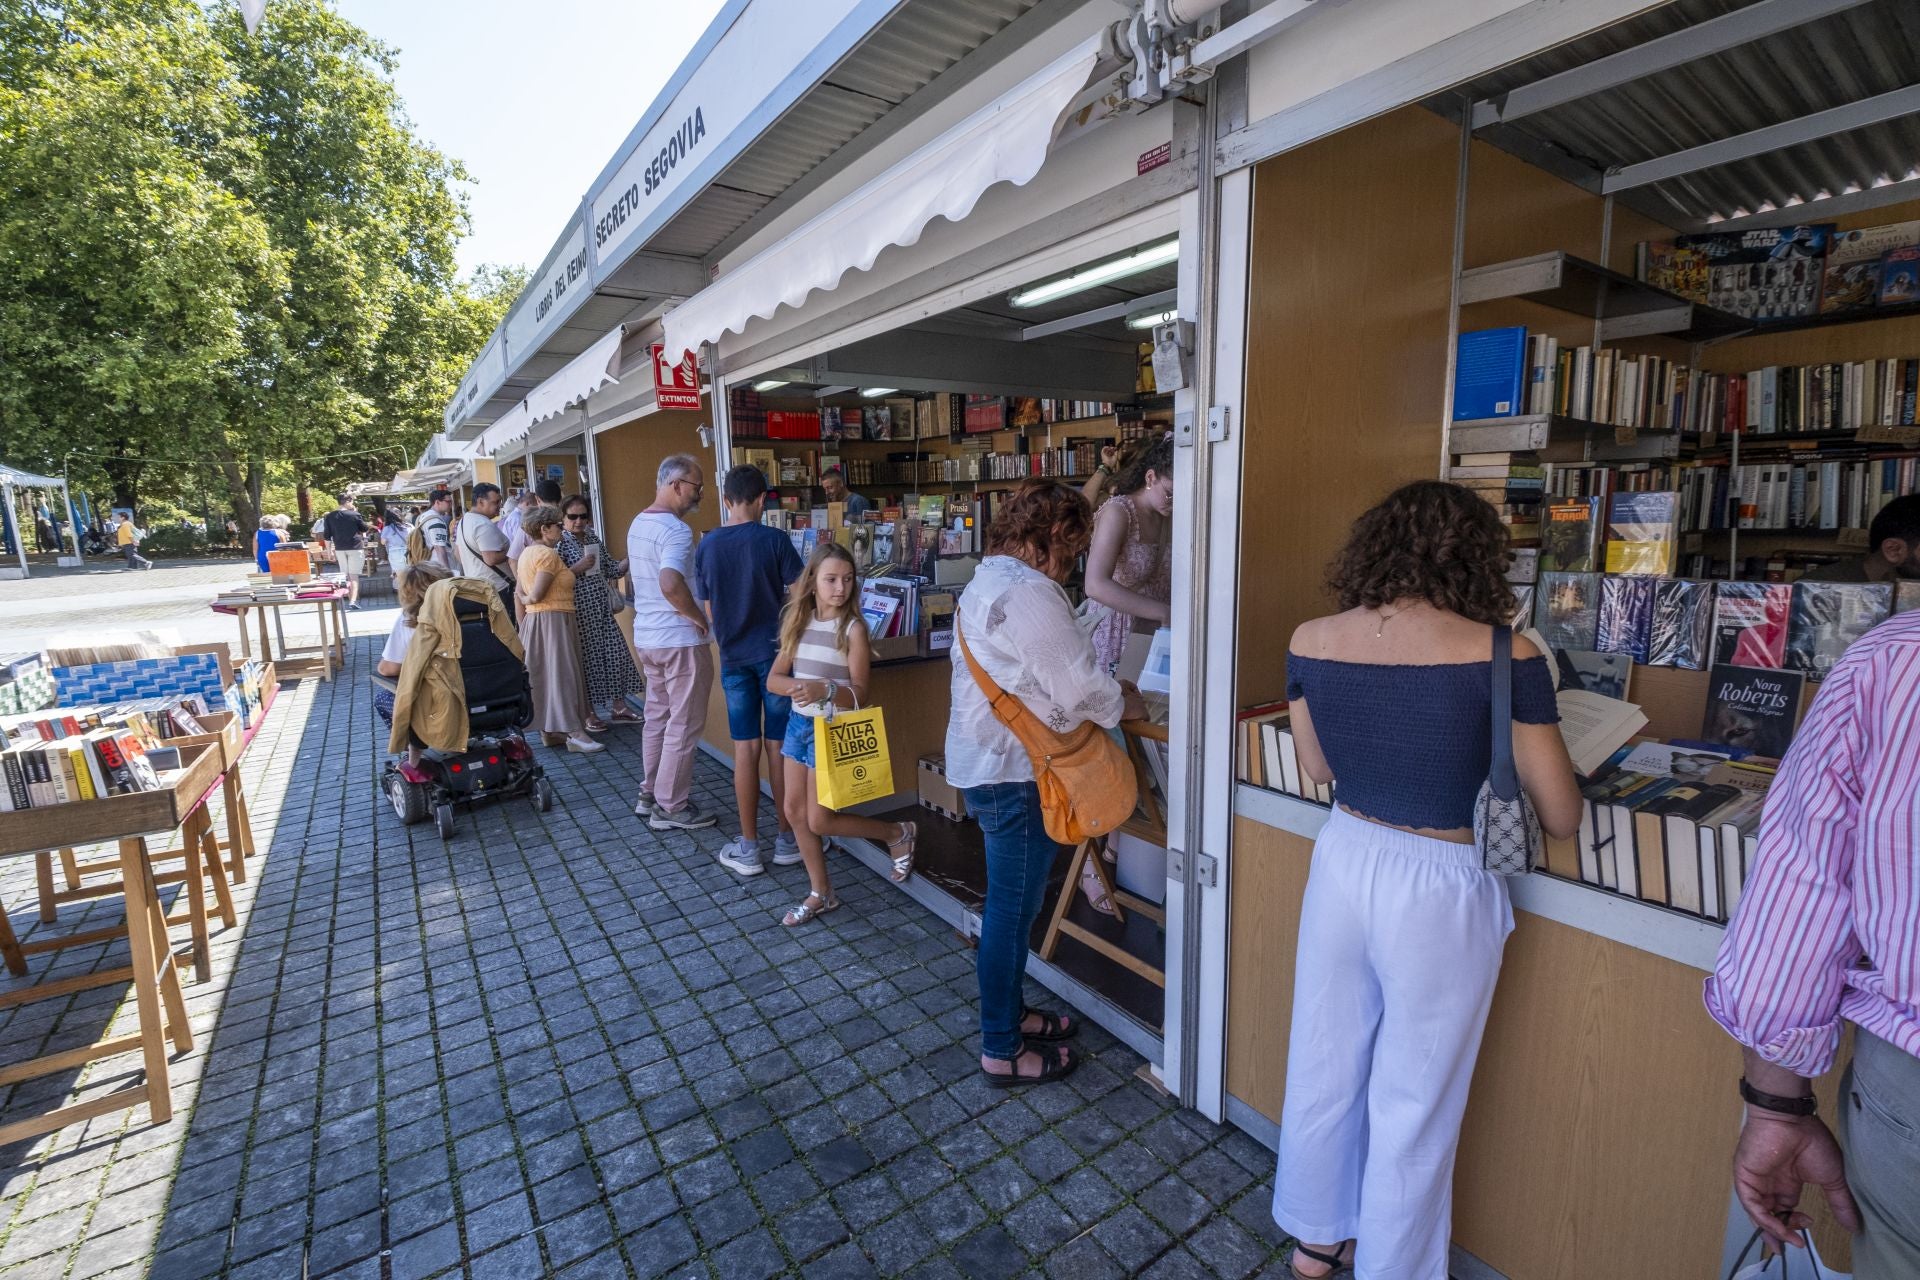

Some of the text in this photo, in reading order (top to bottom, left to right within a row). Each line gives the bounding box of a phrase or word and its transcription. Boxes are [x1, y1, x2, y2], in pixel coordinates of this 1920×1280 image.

[595, 106, 706, 249] SECRETO SEGOVIA
[1741, 229, 1781, 241] STAR
[1742, 237, 1780, 249] WARS
[535, 247, 587, 323] LIBROS DEL REINO
[660, 394, 697, 403] EXTINTOR
[950, 503, 968, 513] Prusia
[1550, 508, 1590, 522] TERROR
[1751, 678, 1782, 692] Nora
[1718, 682, 1789, 708] Roberts
[1728, 702, 1785, 717] Colinas Negras
[835, 722, 875, 741] VILLA
[98, 738, 124, 768] CHE
[838, 736, 878, 757] LIBRO
